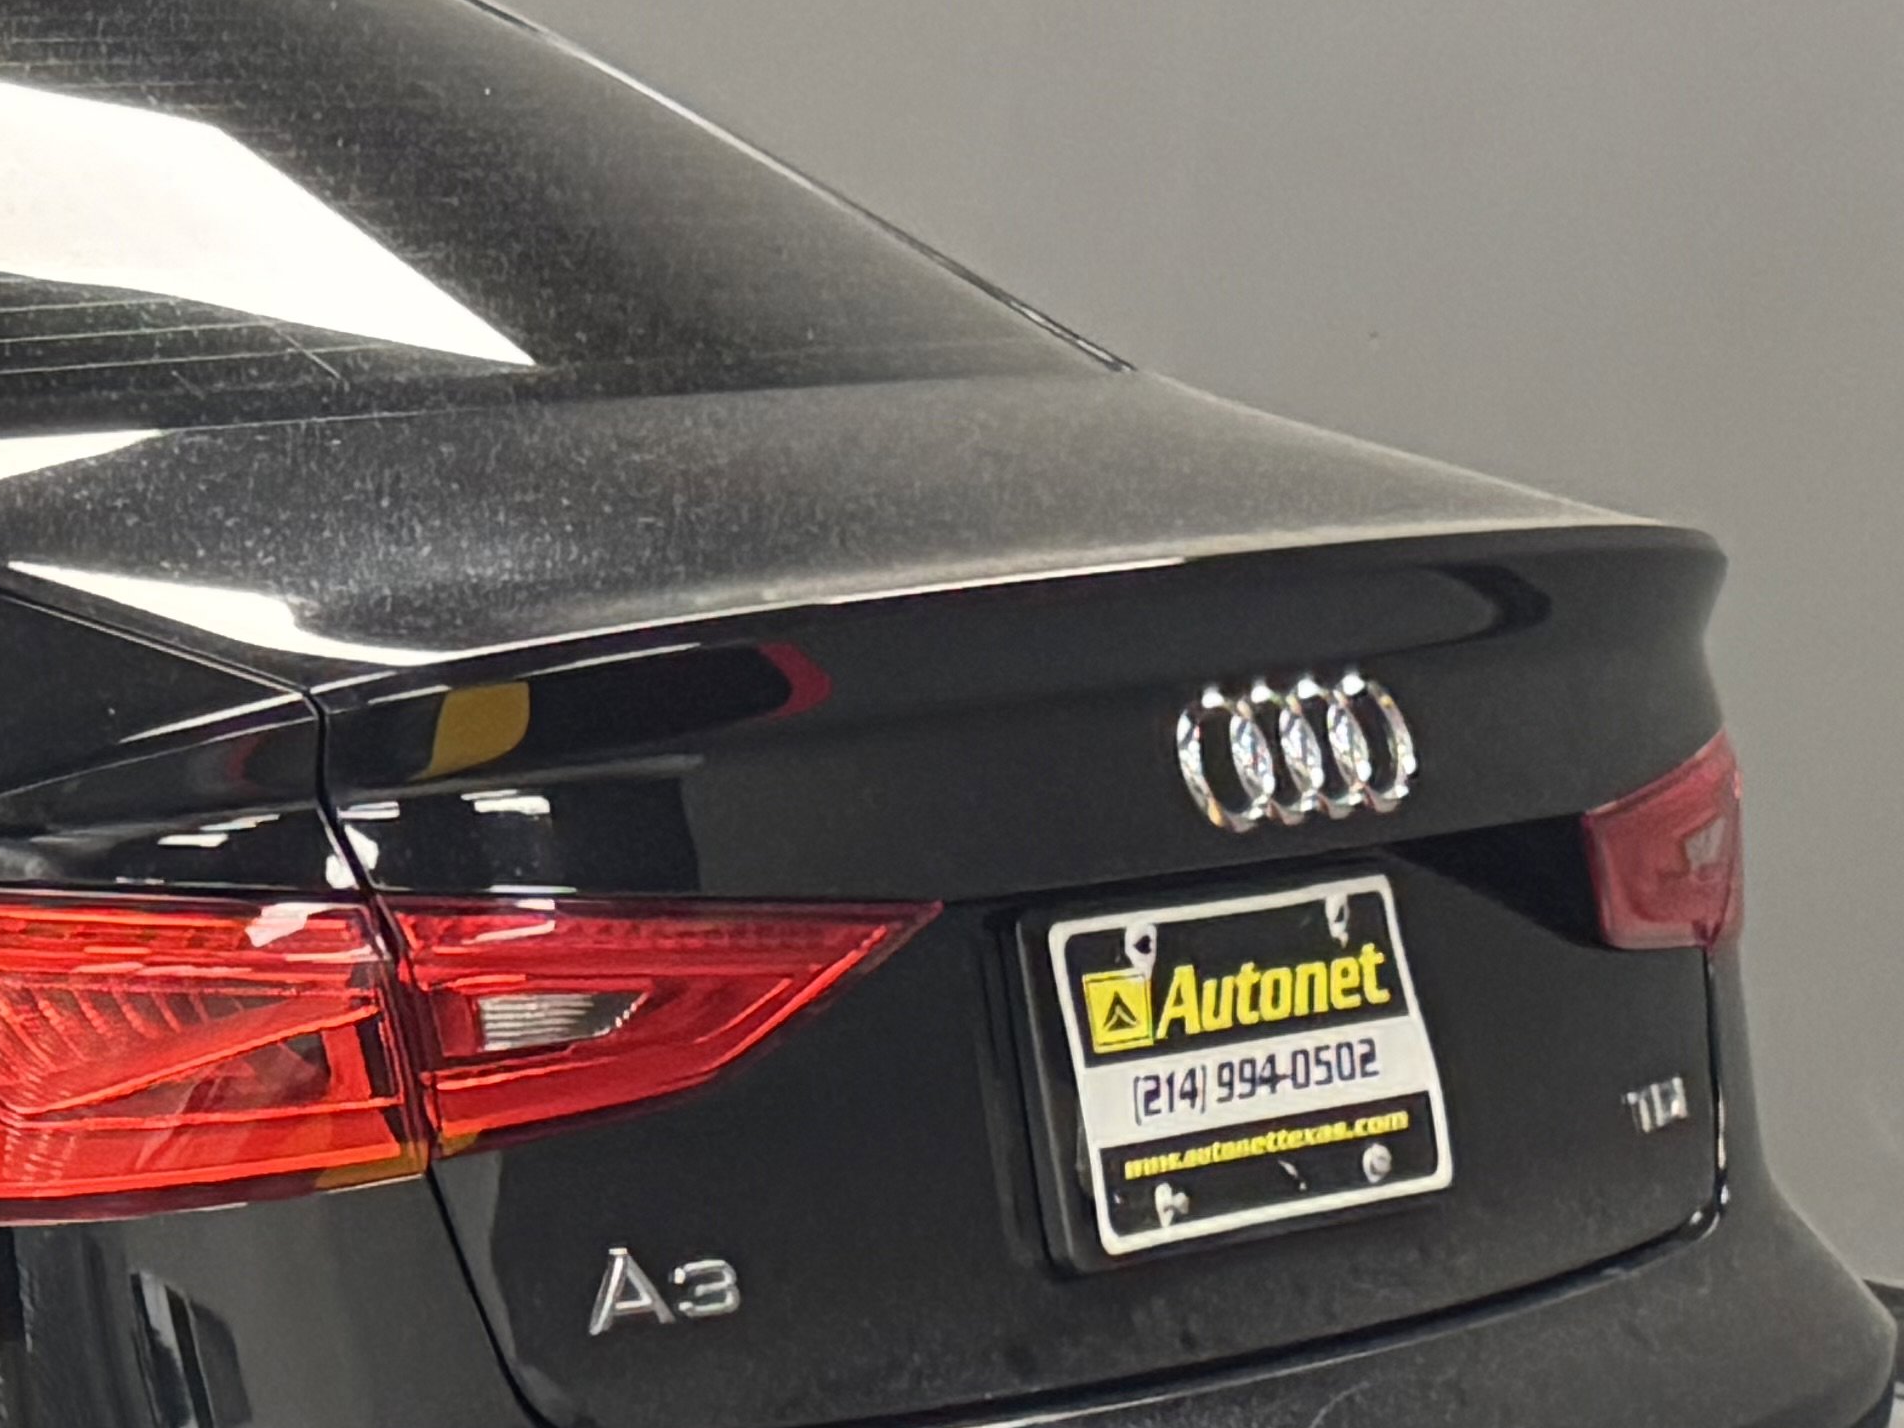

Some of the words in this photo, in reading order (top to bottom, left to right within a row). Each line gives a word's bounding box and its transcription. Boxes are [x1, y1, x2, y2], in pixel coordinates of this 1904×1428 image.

[1155, 942, 1391, 1039] Autonet
[1133, 1064, 1207, 1127] (214)
[1216, 1037, 1380, 1104] 994-0502
[589, 1246, 741, 1336] A3
